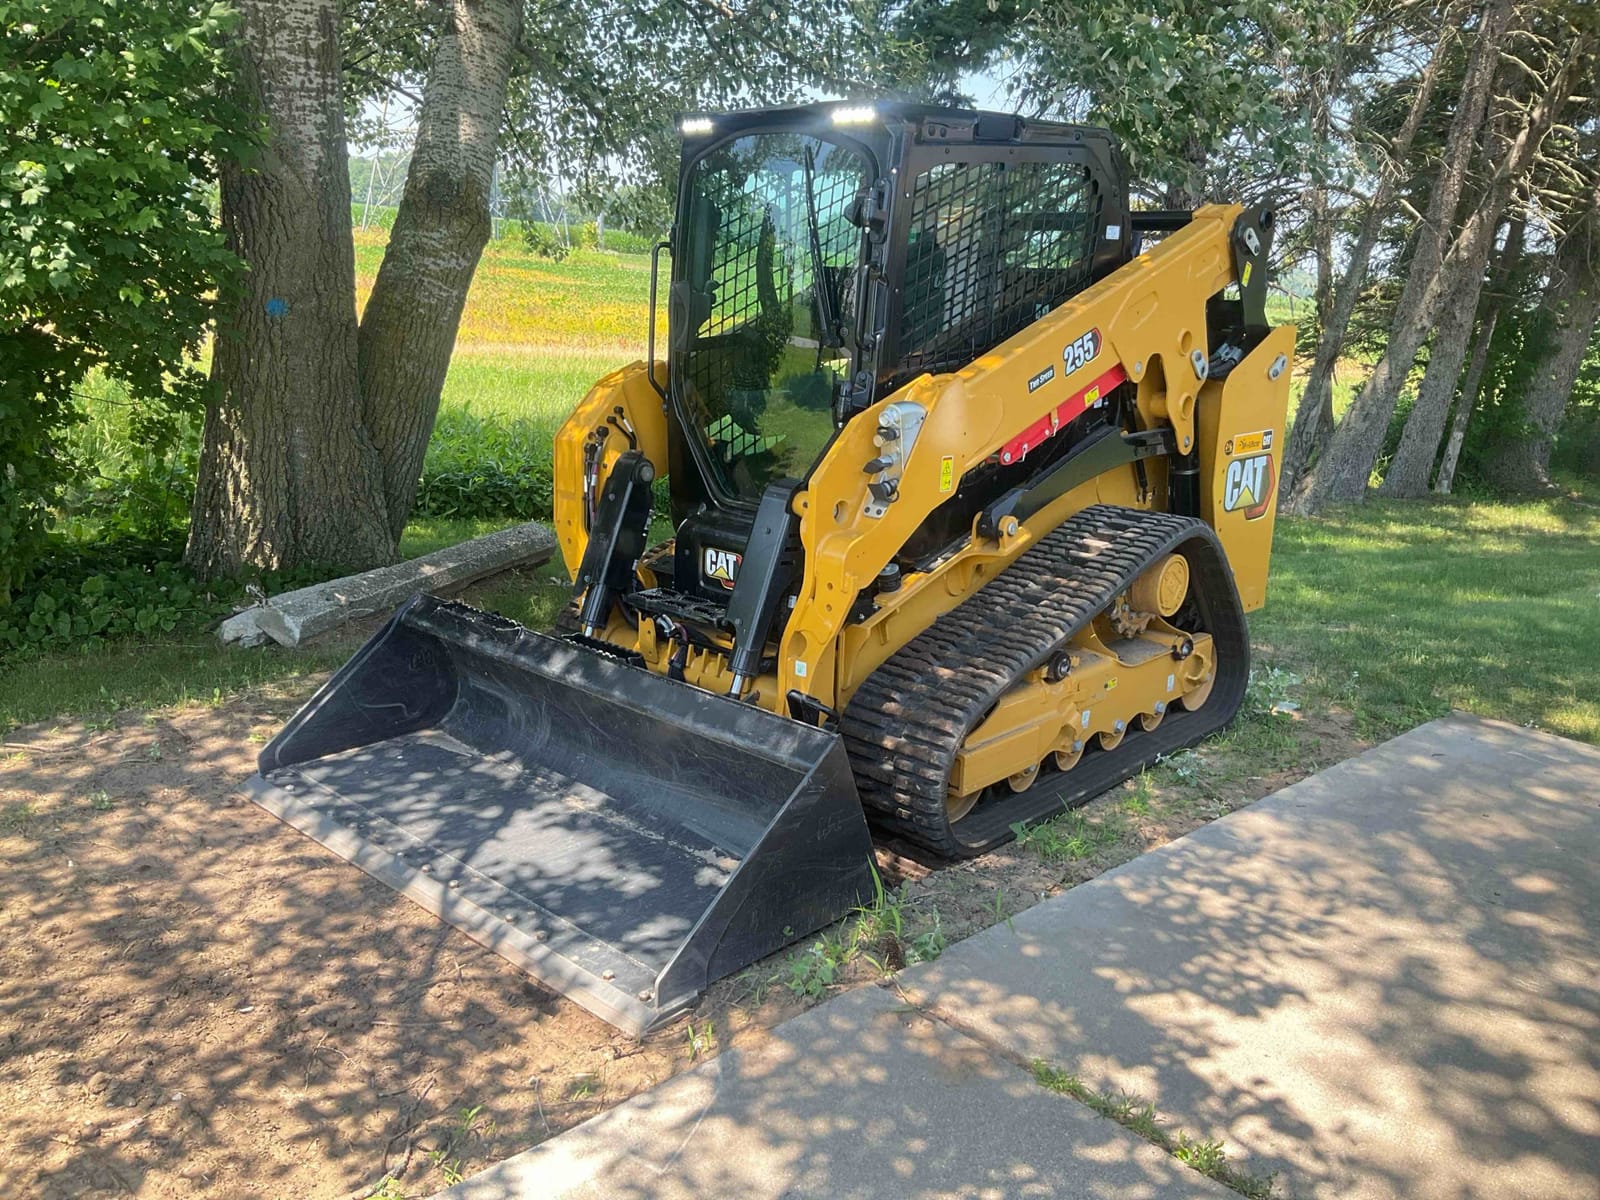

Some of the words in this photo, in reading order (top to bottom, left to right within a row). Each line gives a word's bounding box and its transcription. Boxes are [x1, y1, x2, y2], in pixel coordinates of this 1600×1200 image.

[1063, 331, 1095, 376] 255
[1224, 455, 1268, 511] CAT
[706, 549, 737, 580] CAT
